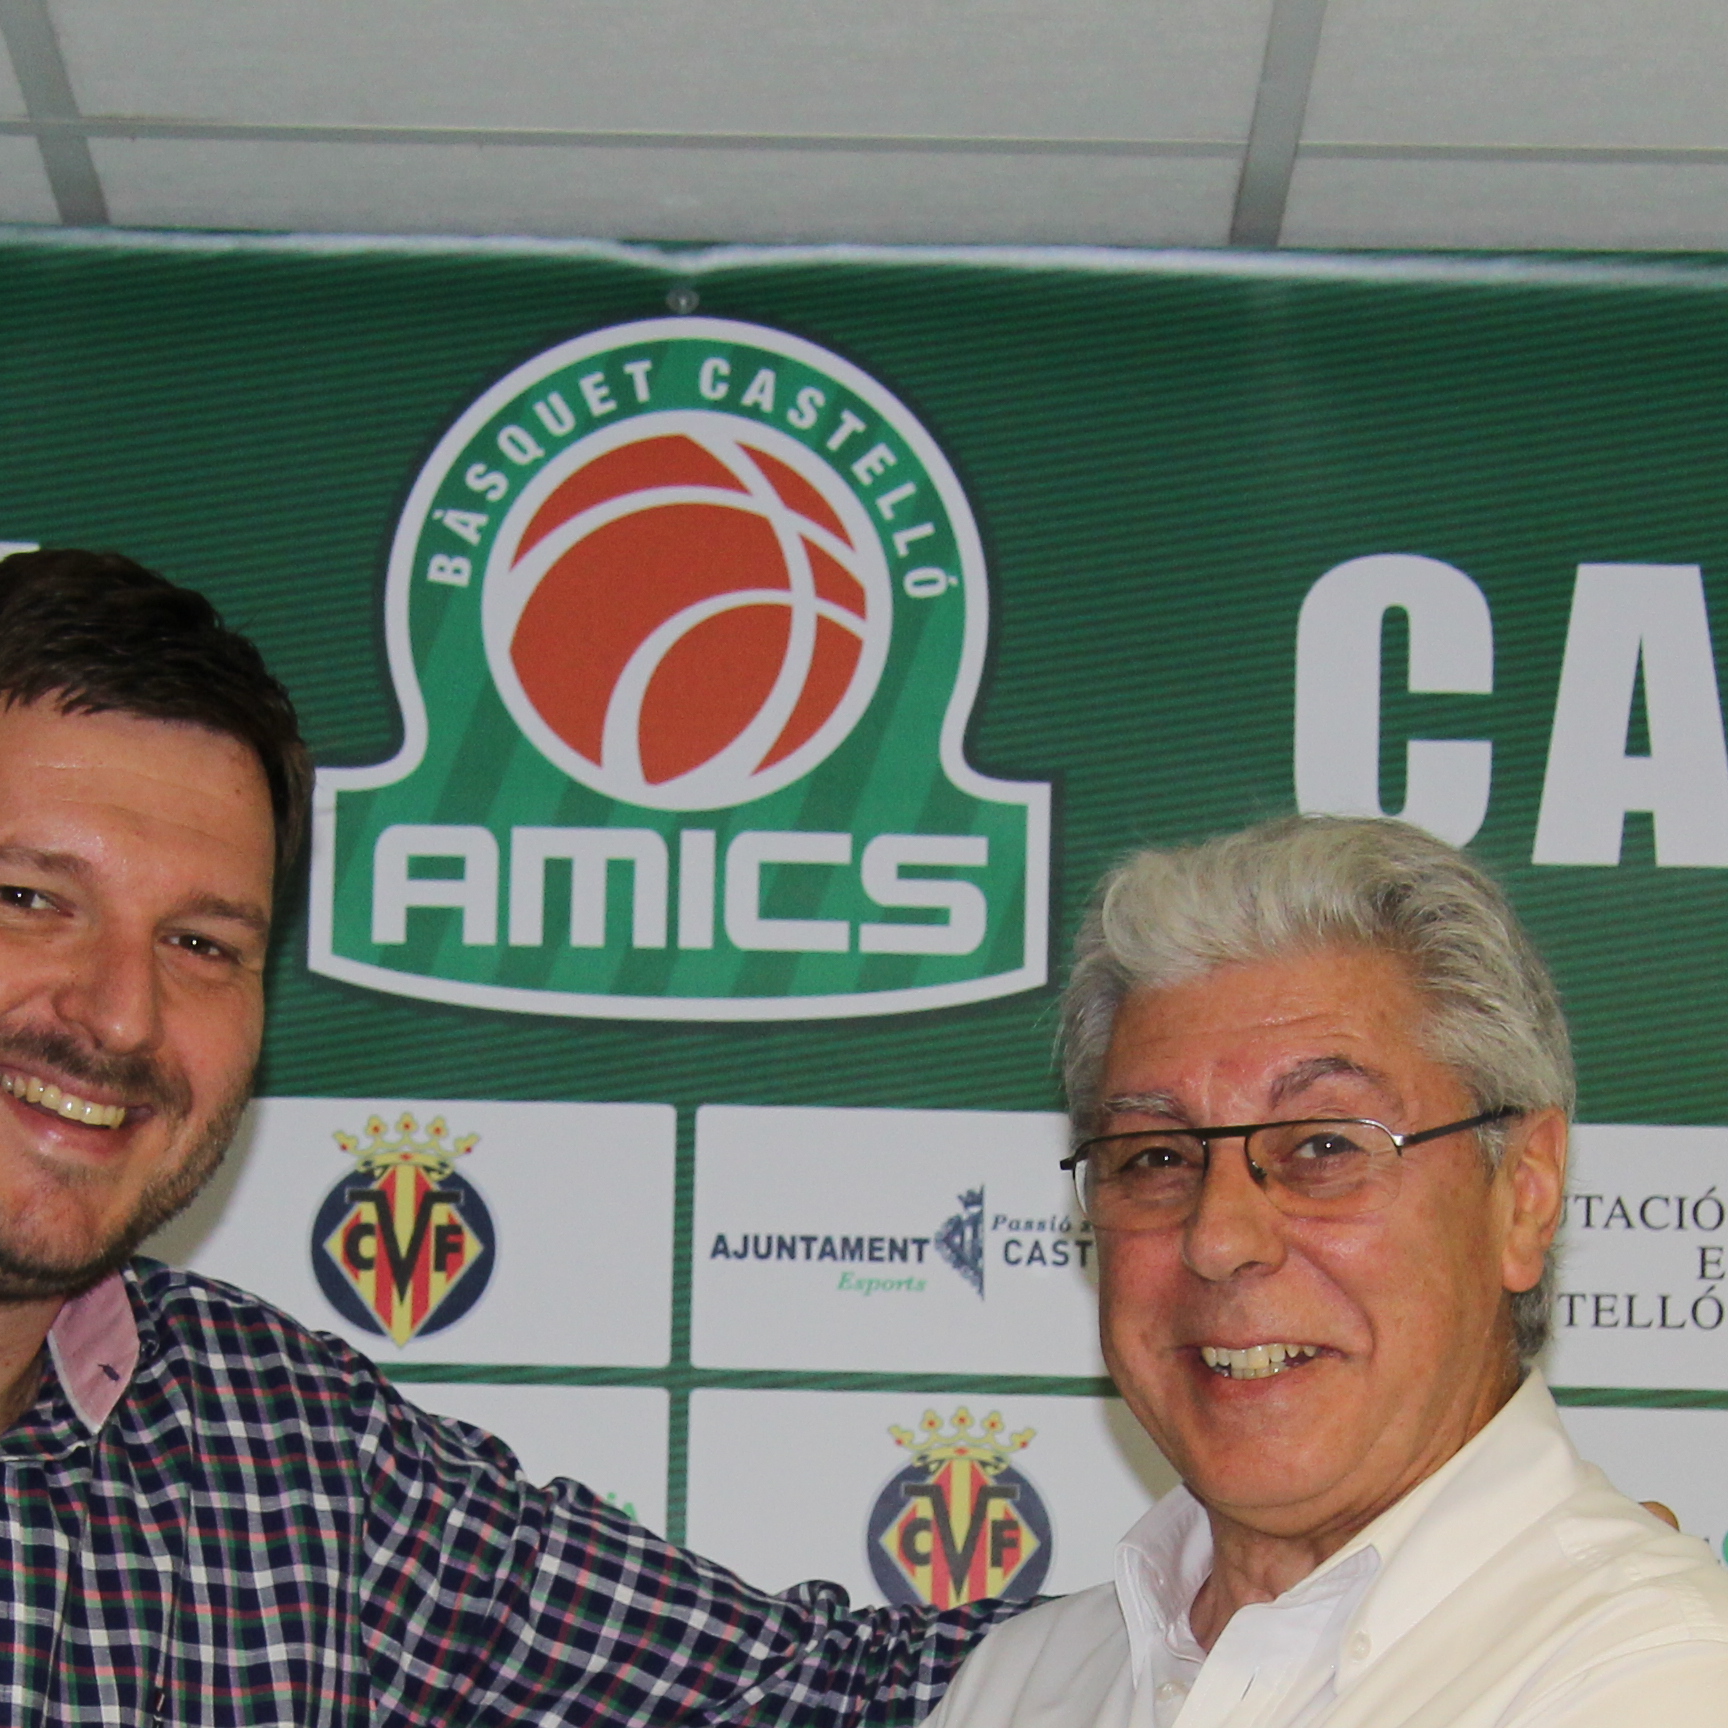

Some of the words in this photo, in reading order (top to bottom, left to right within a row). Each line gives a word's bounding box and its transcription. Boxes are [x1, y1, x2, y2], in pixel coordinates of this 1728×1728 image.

[698, 355, 959, 599] CASTELLÓ
[371, 823, 988, 956] AMICS
[711, 1234, 930, 1264] AJUNTAMENT
[837, 1272, 926, 1297] Esports
